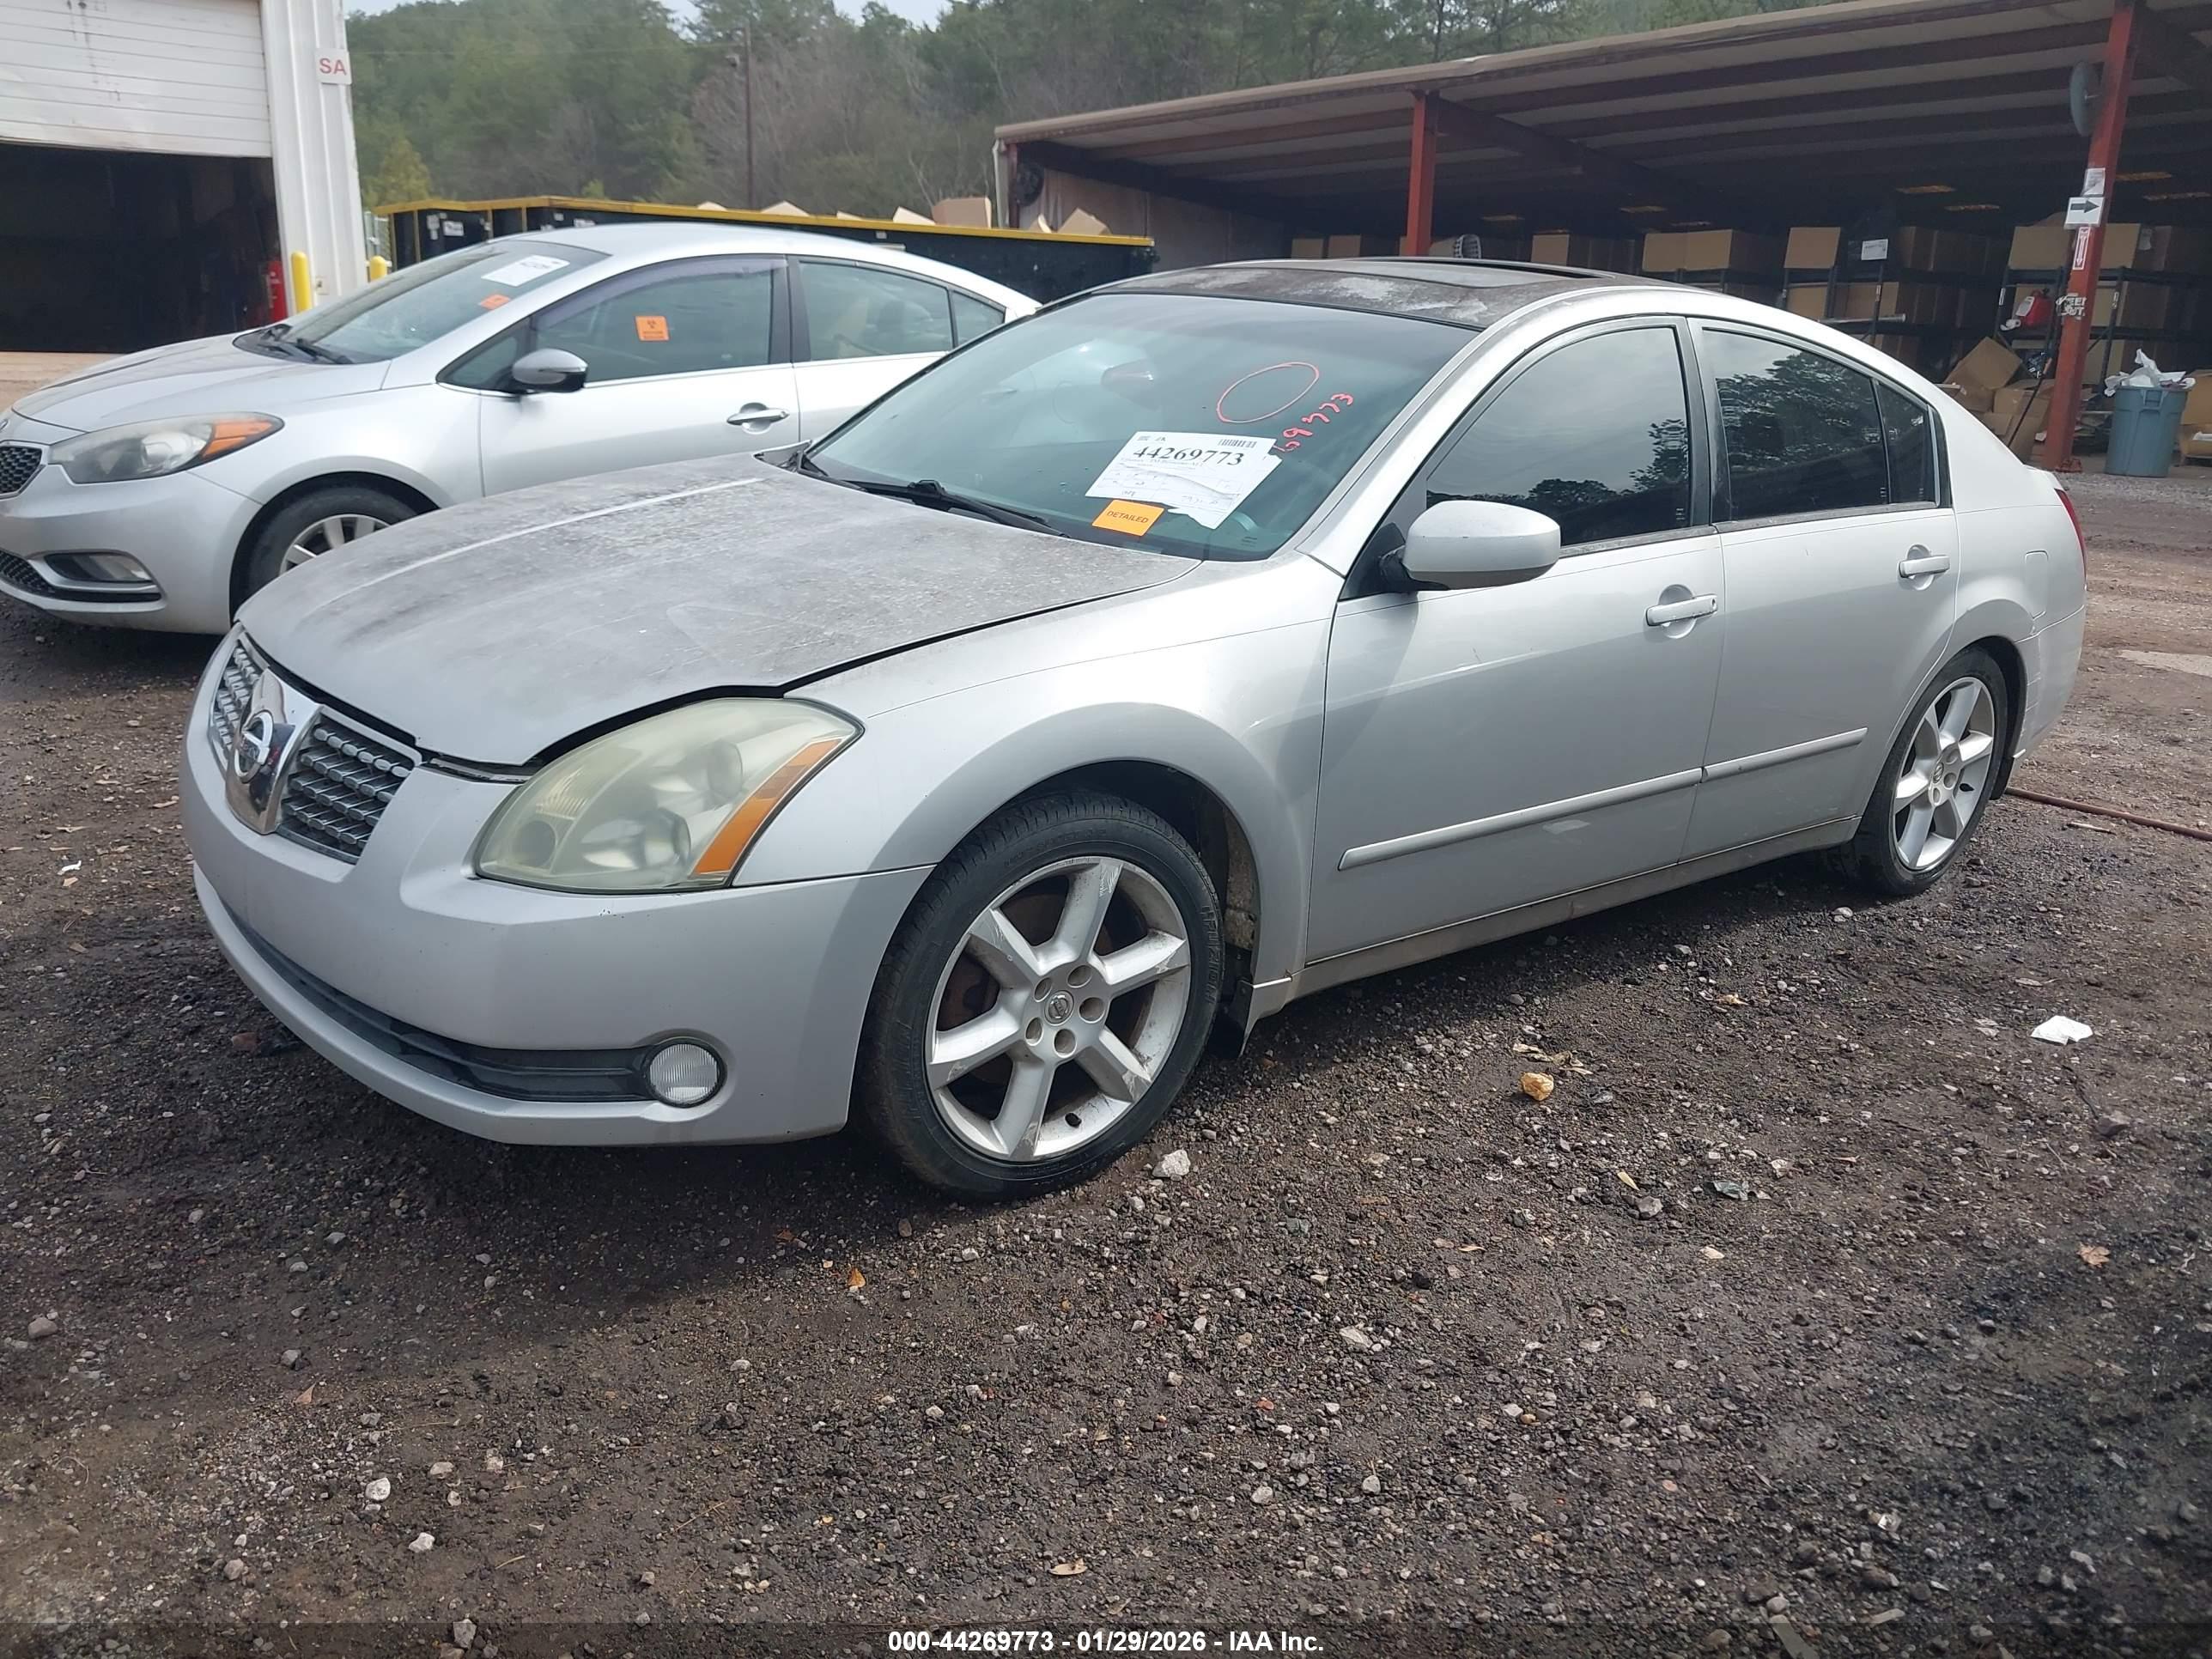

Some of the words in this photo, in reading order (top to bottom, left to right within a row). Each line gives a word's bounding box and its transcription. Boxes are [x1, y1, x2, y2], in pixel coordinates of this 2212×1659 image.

[319, 57, 348, 76] SA
[1133, 446, 1244, 466] 44269773
[1106, 510, 1150, 524] DETAILED
